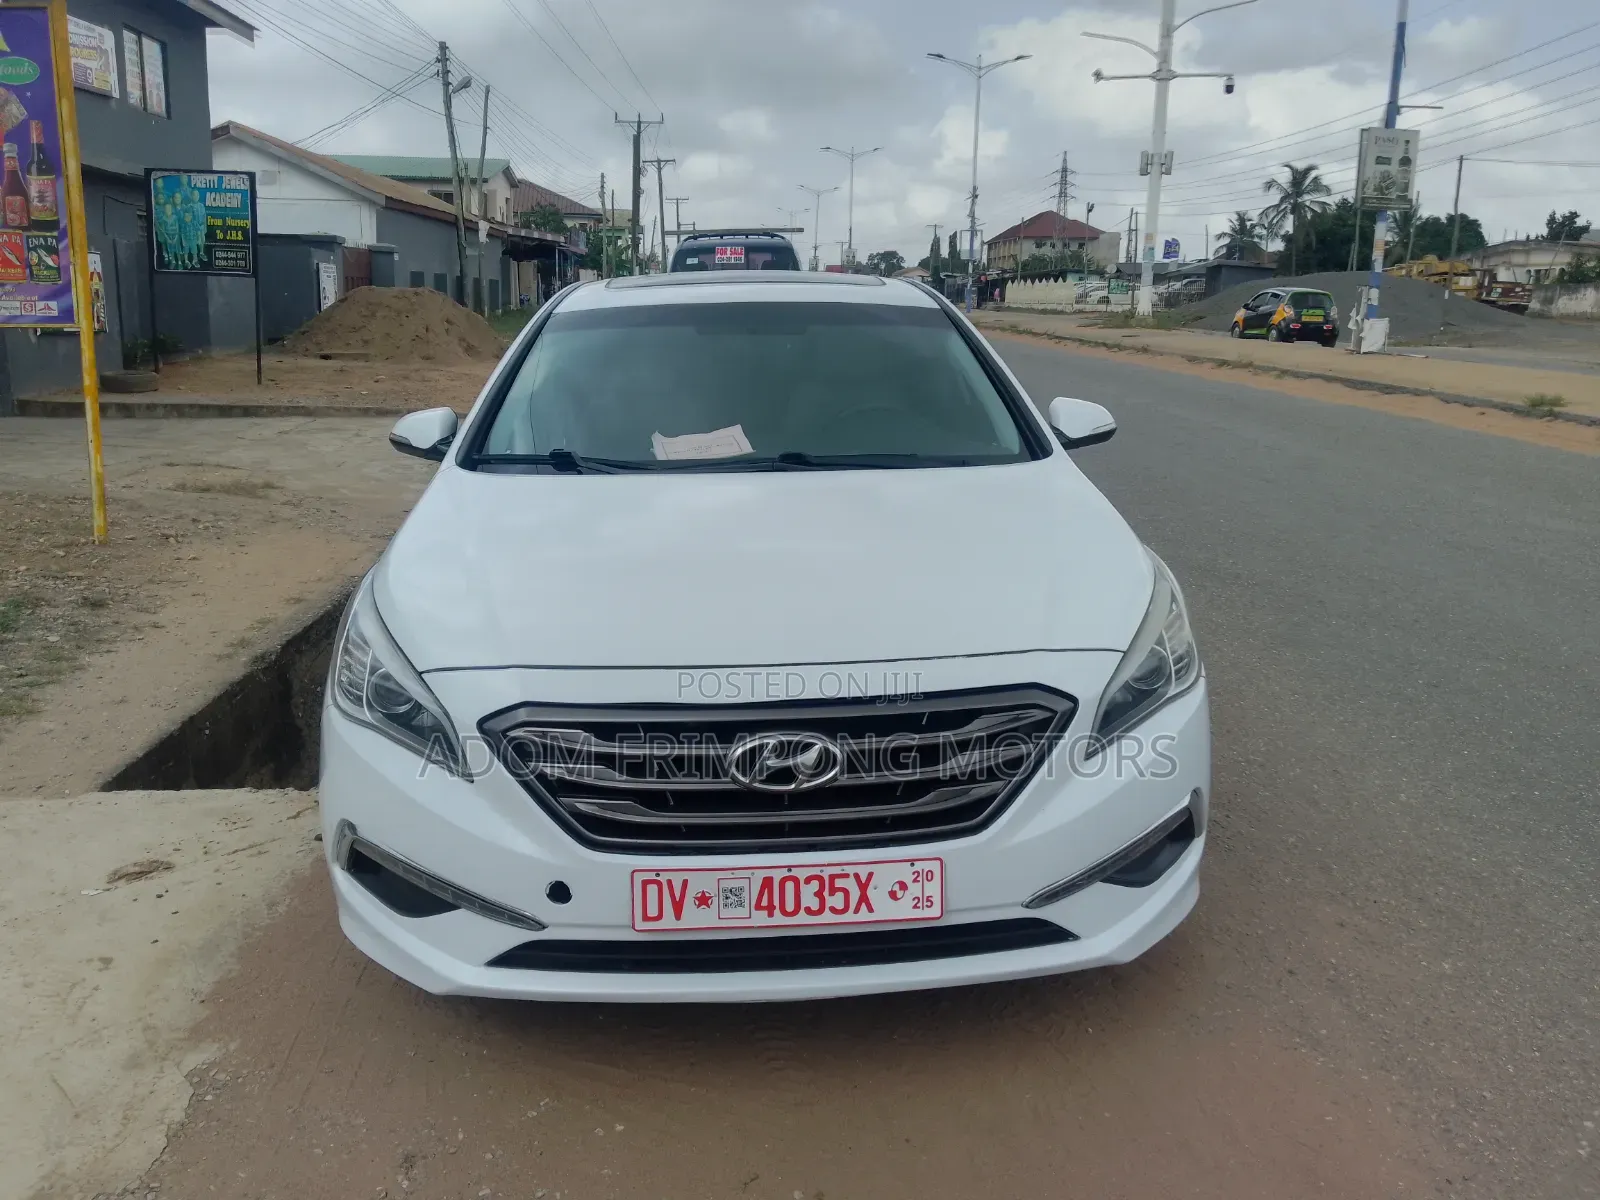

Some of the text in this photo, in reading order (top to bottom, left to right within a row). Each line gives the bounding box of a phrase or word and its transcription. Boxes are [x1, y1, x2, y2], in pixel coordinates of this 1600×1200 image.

[190, 175, 250, 190] PRETTY JEWELS
[205, 191, 242, 208] ACADEMY
[207, 215, 250, 229] From Nursery
[215, 229, 224, 240] To
[28, 237, 58, 249] ENA PA
[716, 247, 744, 256] FOR SALE
[911, 869, 935, 884] 20
[640, 871, 876, 922] DV 4035X
[911, 894, 935, 910] 25
